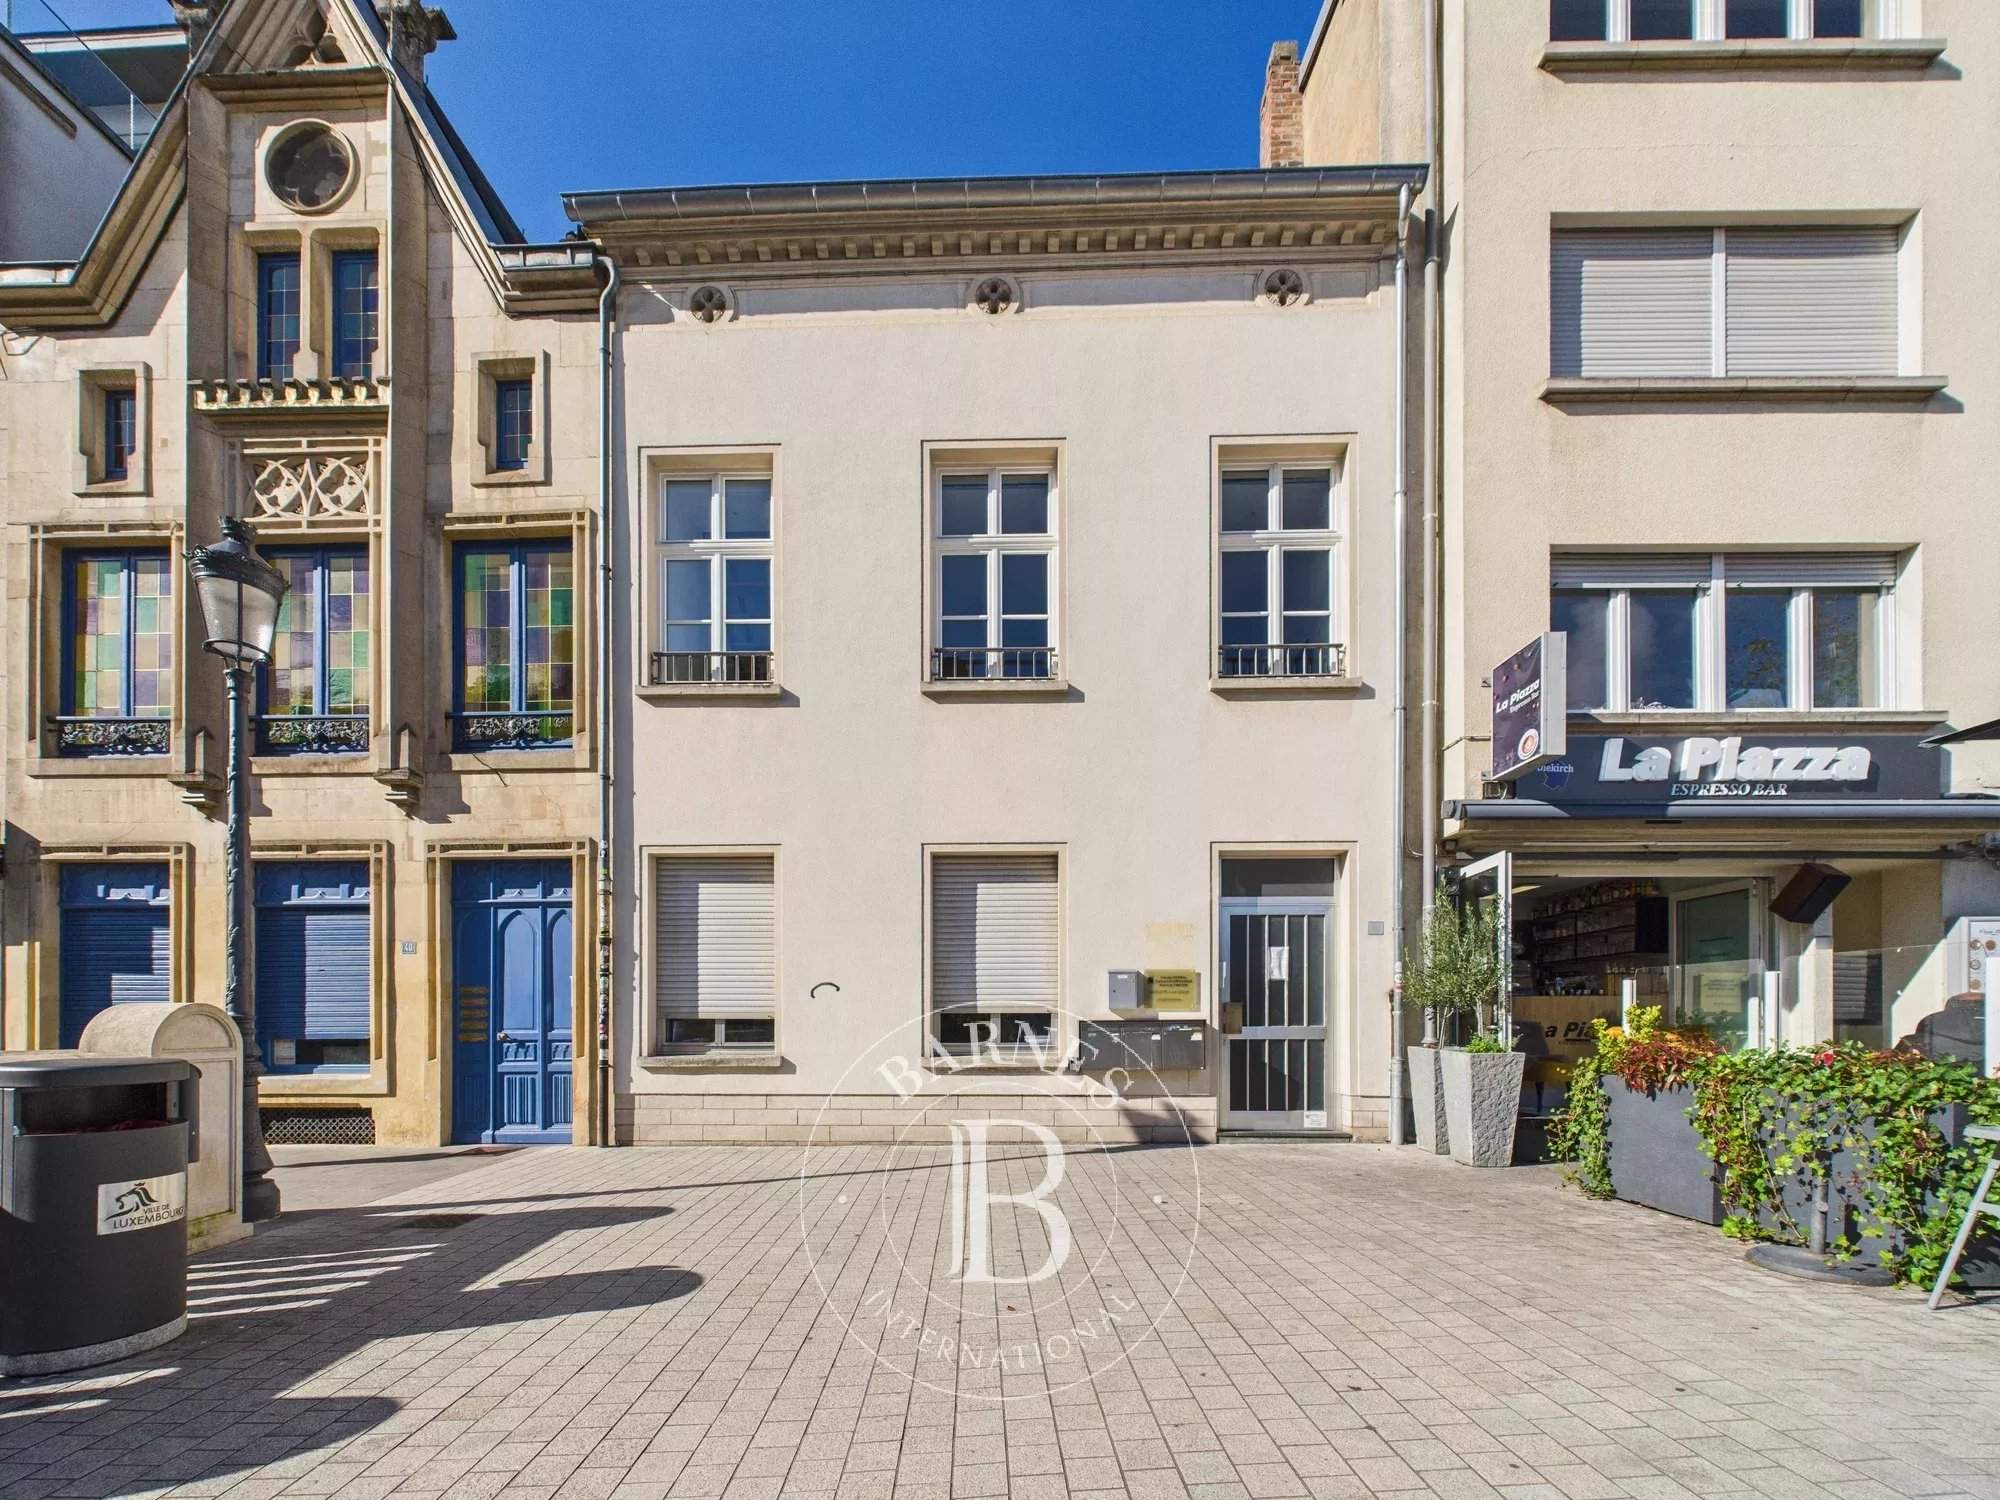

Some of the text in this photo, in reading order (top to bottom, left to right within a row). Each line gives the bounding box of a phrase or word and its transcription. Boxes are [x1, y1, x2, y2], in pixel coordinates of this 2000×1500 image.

[1496, 679, 1540, 713] La Piazza
[1598, 736, 1872, 781] La Piazza
[1671, 783, 1788, 796] ESPRESSO BAR
[113, 1206, 184, 1229] LUXEMBOURG
[143, 1203, 170, 1214] VILLE DE
